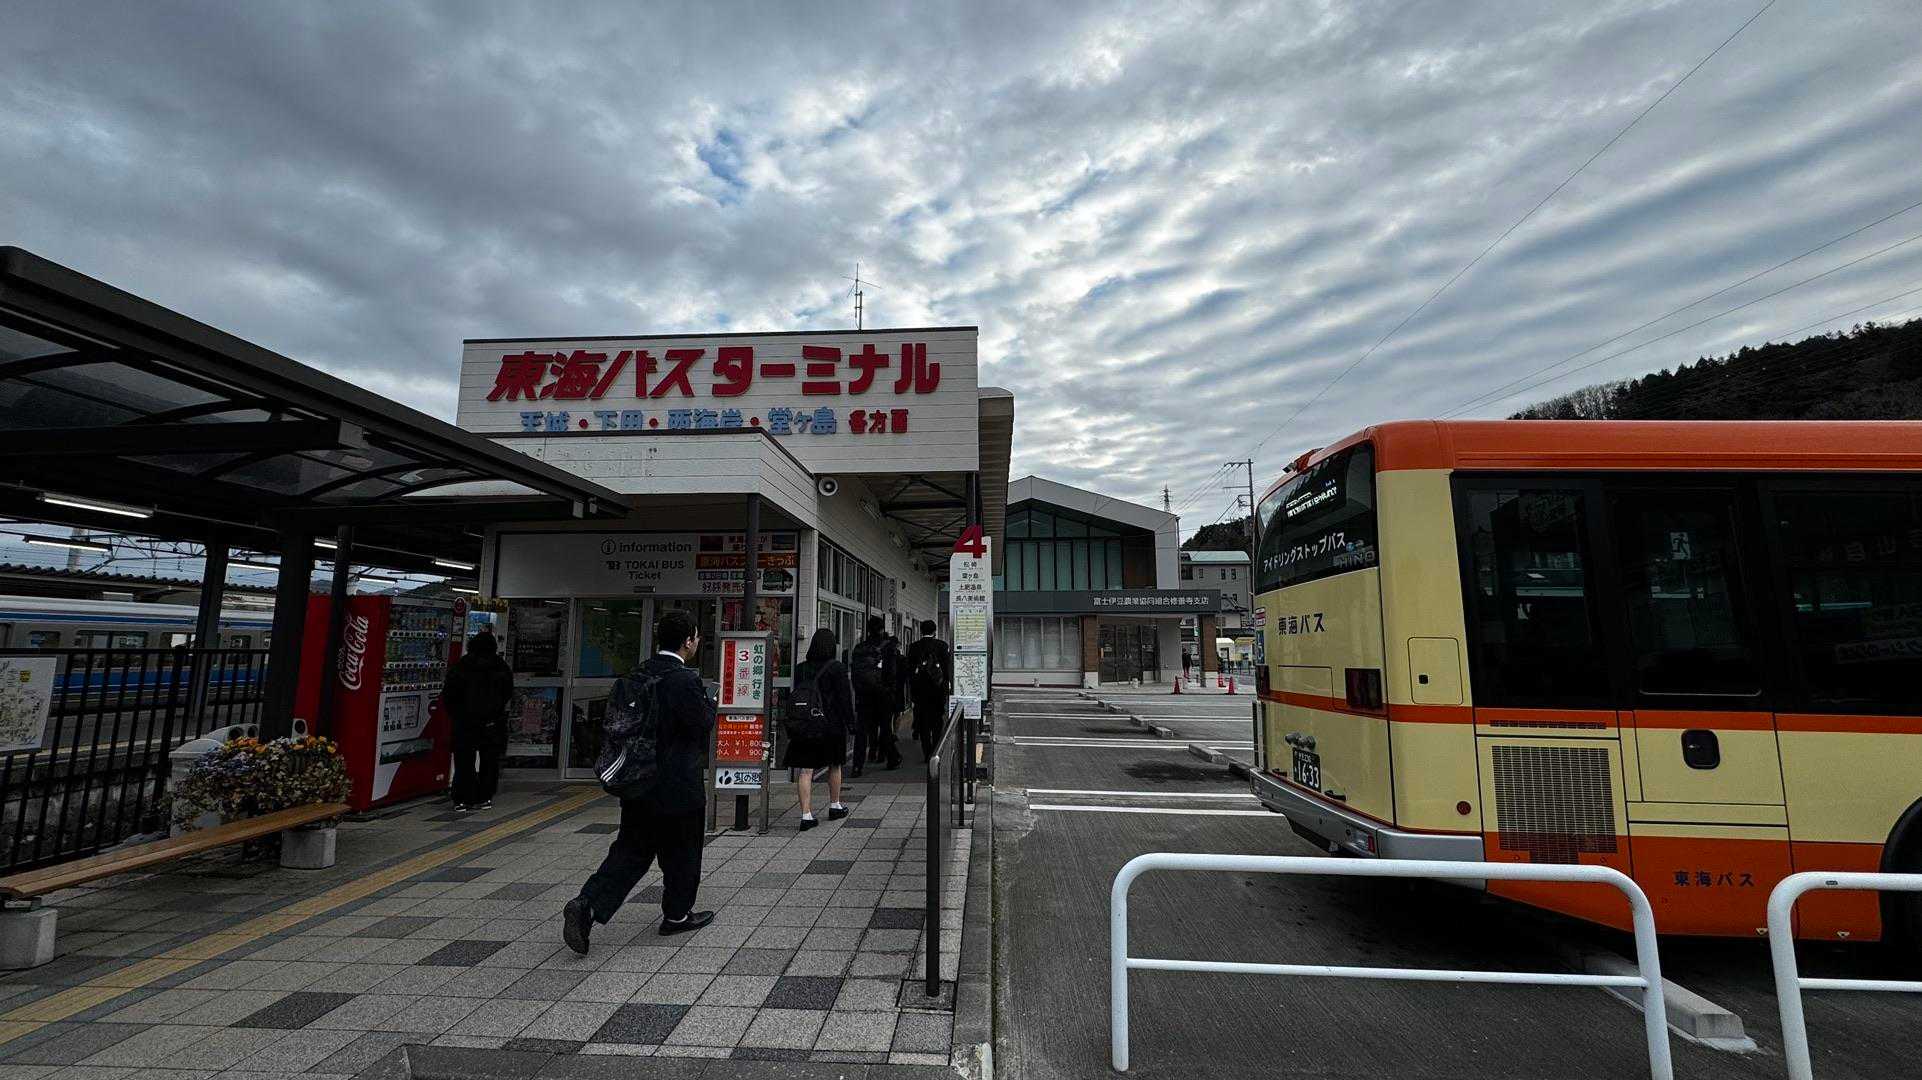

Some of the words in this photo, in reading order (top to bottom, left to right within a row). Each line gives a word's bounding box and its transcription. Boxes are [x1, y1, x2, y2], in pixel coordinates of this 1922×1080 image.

[486, 342, 941, 401] 東海バスターミナル
[848, 408, 909, 434] 各方面
[953, 524, 987, 558] 4
[1263, 531, 1346, 573] アイドリングストップバス
[625, 560, 658, 569] TOKAI
[662, 560, 685, 569] BUS
[629, 571, 661, 580] Ticket
[1278, 612, 1325, 636] 東海バス
[1673, 870, 1755, 888] 東海バス
